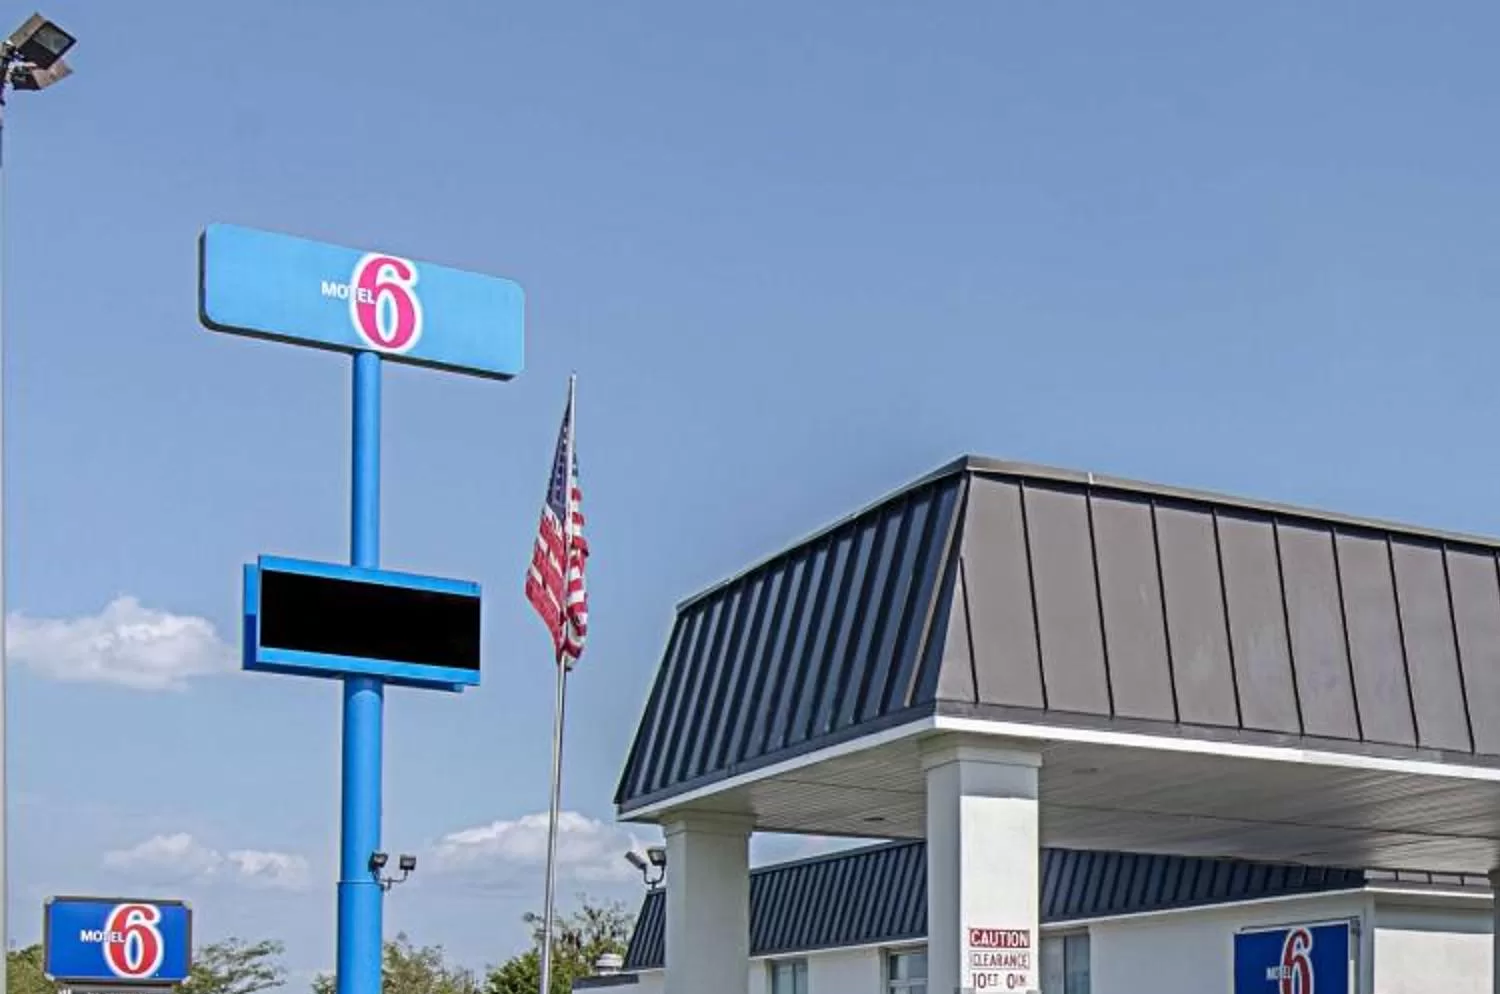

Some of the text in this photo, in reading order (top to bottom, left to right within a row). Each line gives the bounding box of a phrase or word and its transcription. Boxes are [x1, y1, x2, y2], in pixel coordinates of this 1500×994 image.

[320, 252, 423, 354] MOTEL 6
[80, 903, 163, 979] MOTEL 6
[971, 930, 1028, 947] CAUTION
[971, 953, 1028, 968] CLEARANCE
